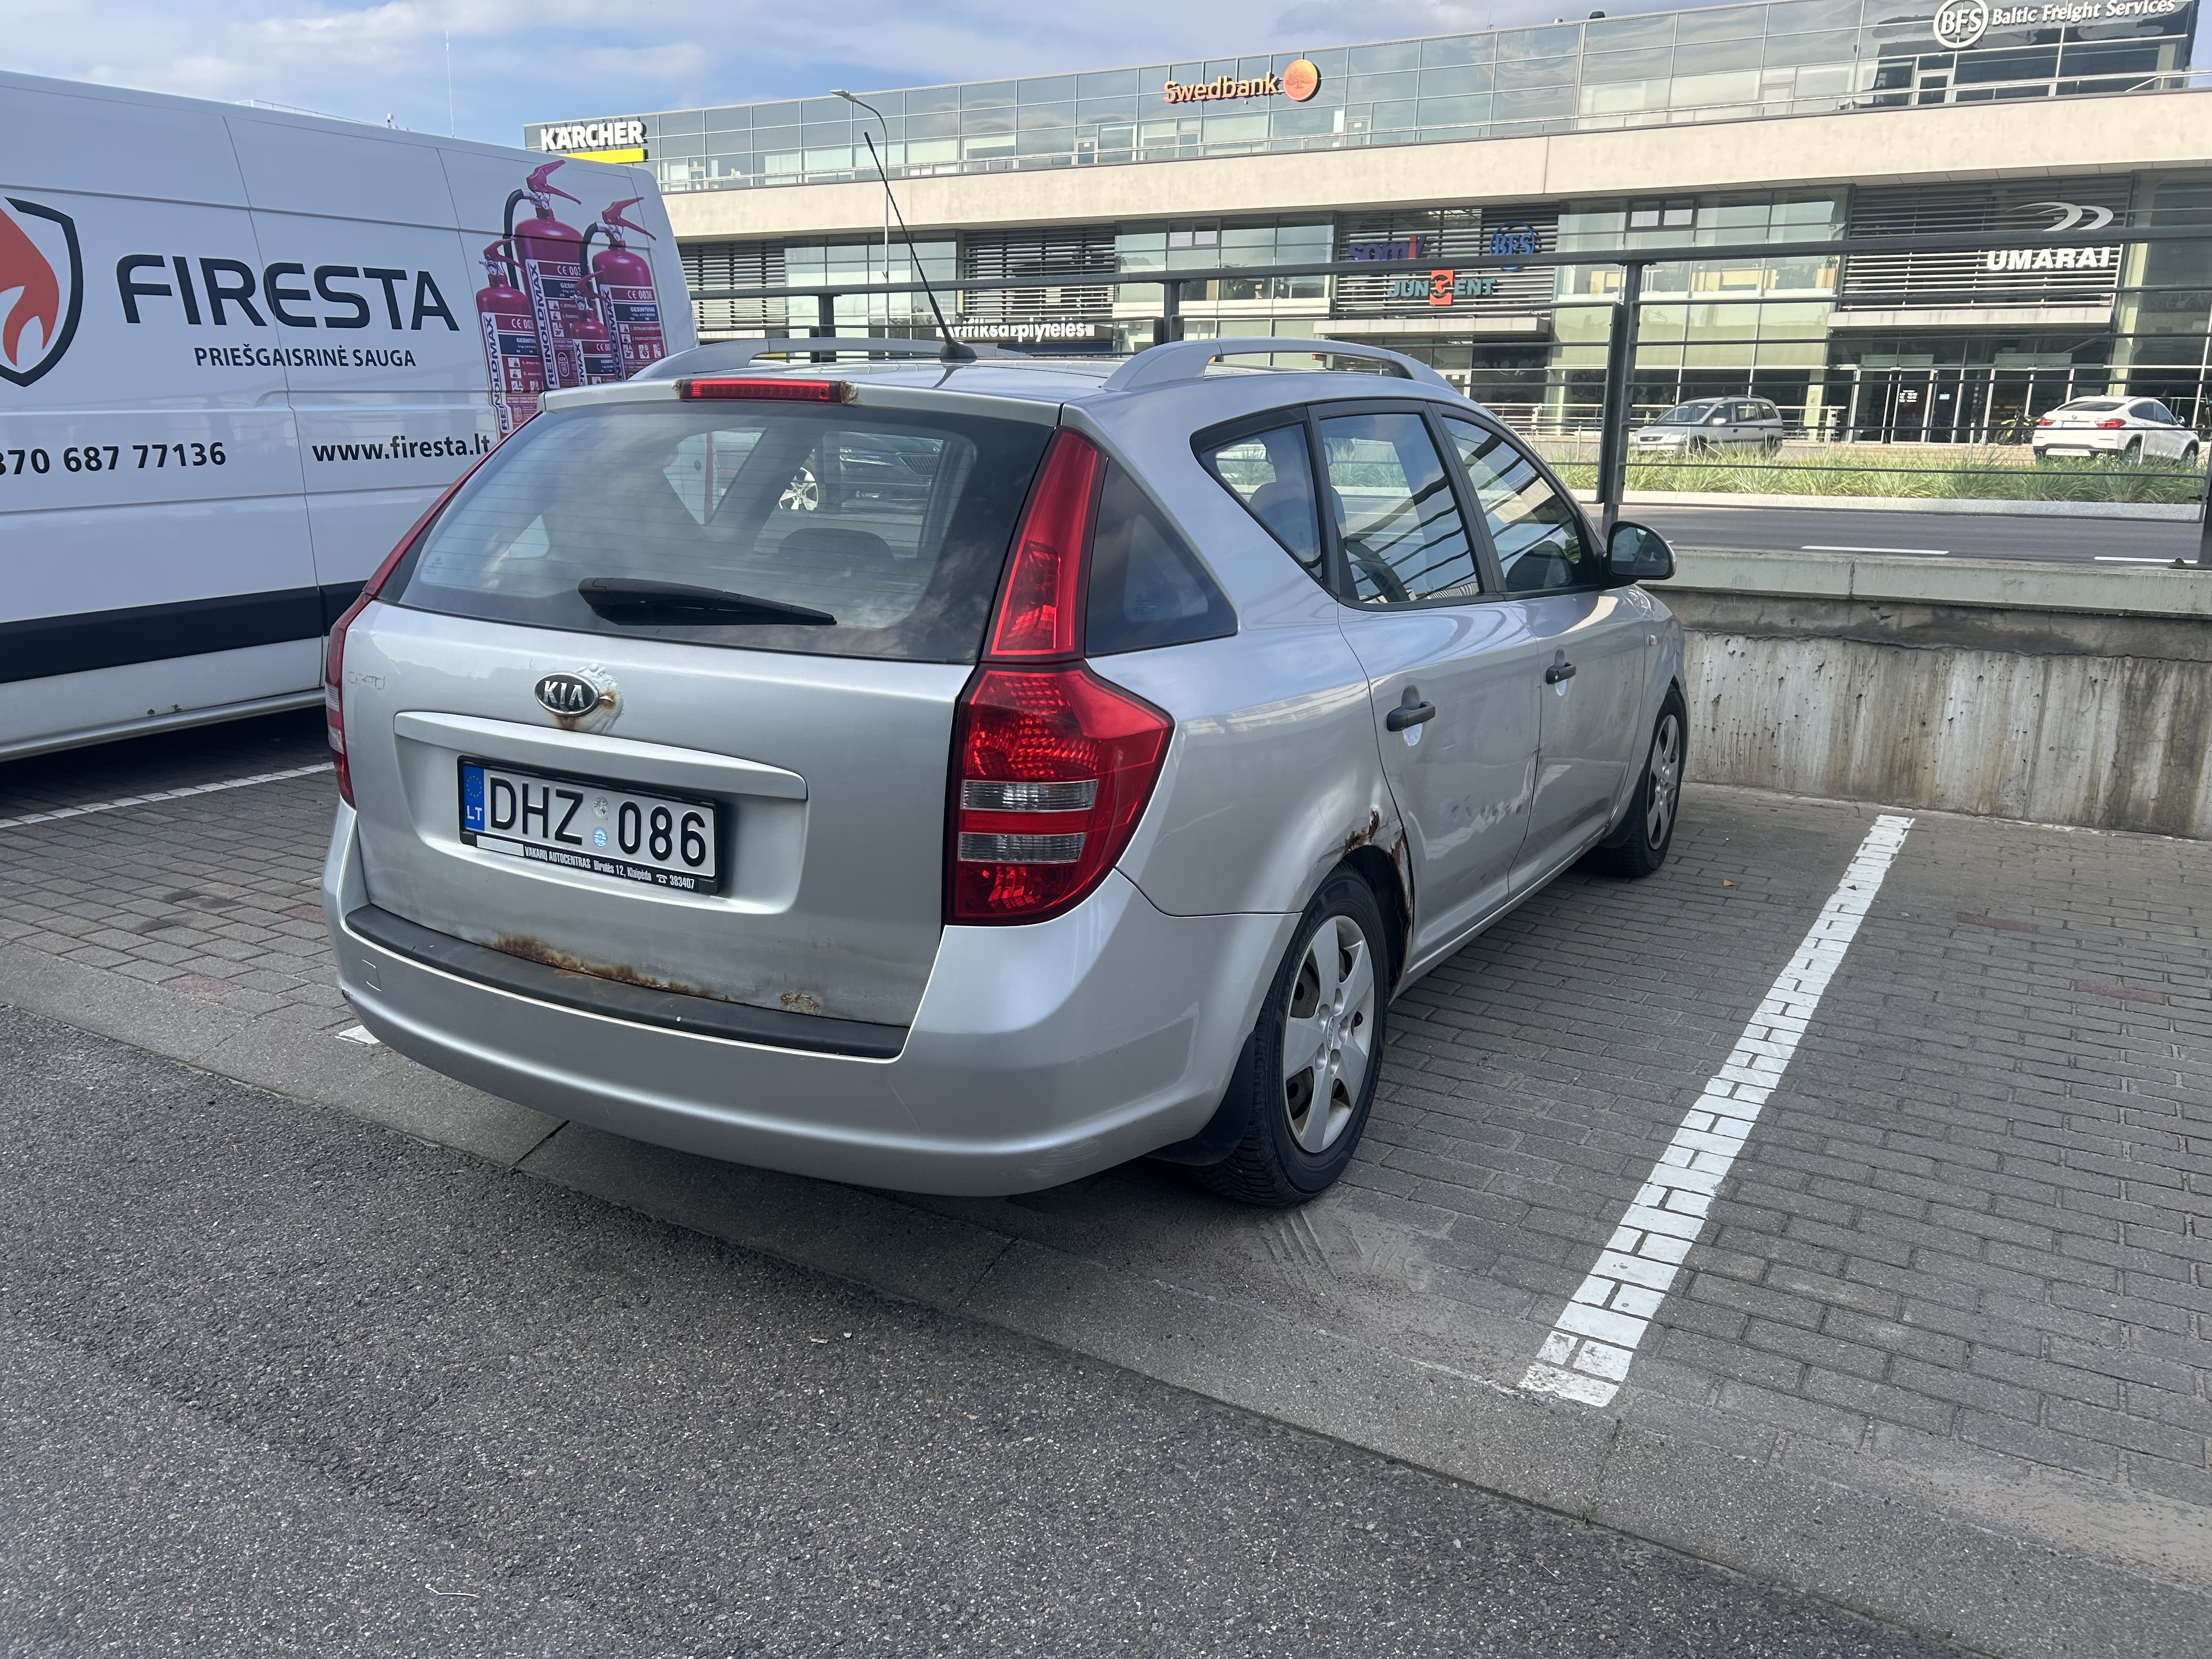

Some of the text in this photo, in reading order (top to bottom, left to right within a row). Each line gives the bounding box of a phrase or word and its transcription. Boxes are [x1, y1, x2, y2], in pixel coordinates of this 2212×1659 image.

[1940, 8, 1983, 35] BFS
[1991, 0, 2175, 26] Baltic Freight Services
[1163, 71, 1279, 103] Swedbank
[1494, 233, 1533, 255] BFS
[1986, 246, 2111, 271] UMARAI
[116, 253, 460, 331] FIRESTA
[194, 343, 416, 367] PRIEŠGAISRINĖ SAUGA
[485, 317, 508, 431] REINOLDMAX
[63, 445, 119, 473] 687
[132, 442, 226, 469] 77136
[312, 433, 490, 462] www.firesta.lt
[543, 680, 586, 708] KIA
[466, 805, 484, 821] LT
[490, 776, 707, 867] DHZ 086
[524, 846, 548, 862] VAKARŲ
[549, 851, 591, 869] AUTOCENTRAS
[627, 866, 652, 882] Klaipėda
[669, 874, 695, 889] 383407
